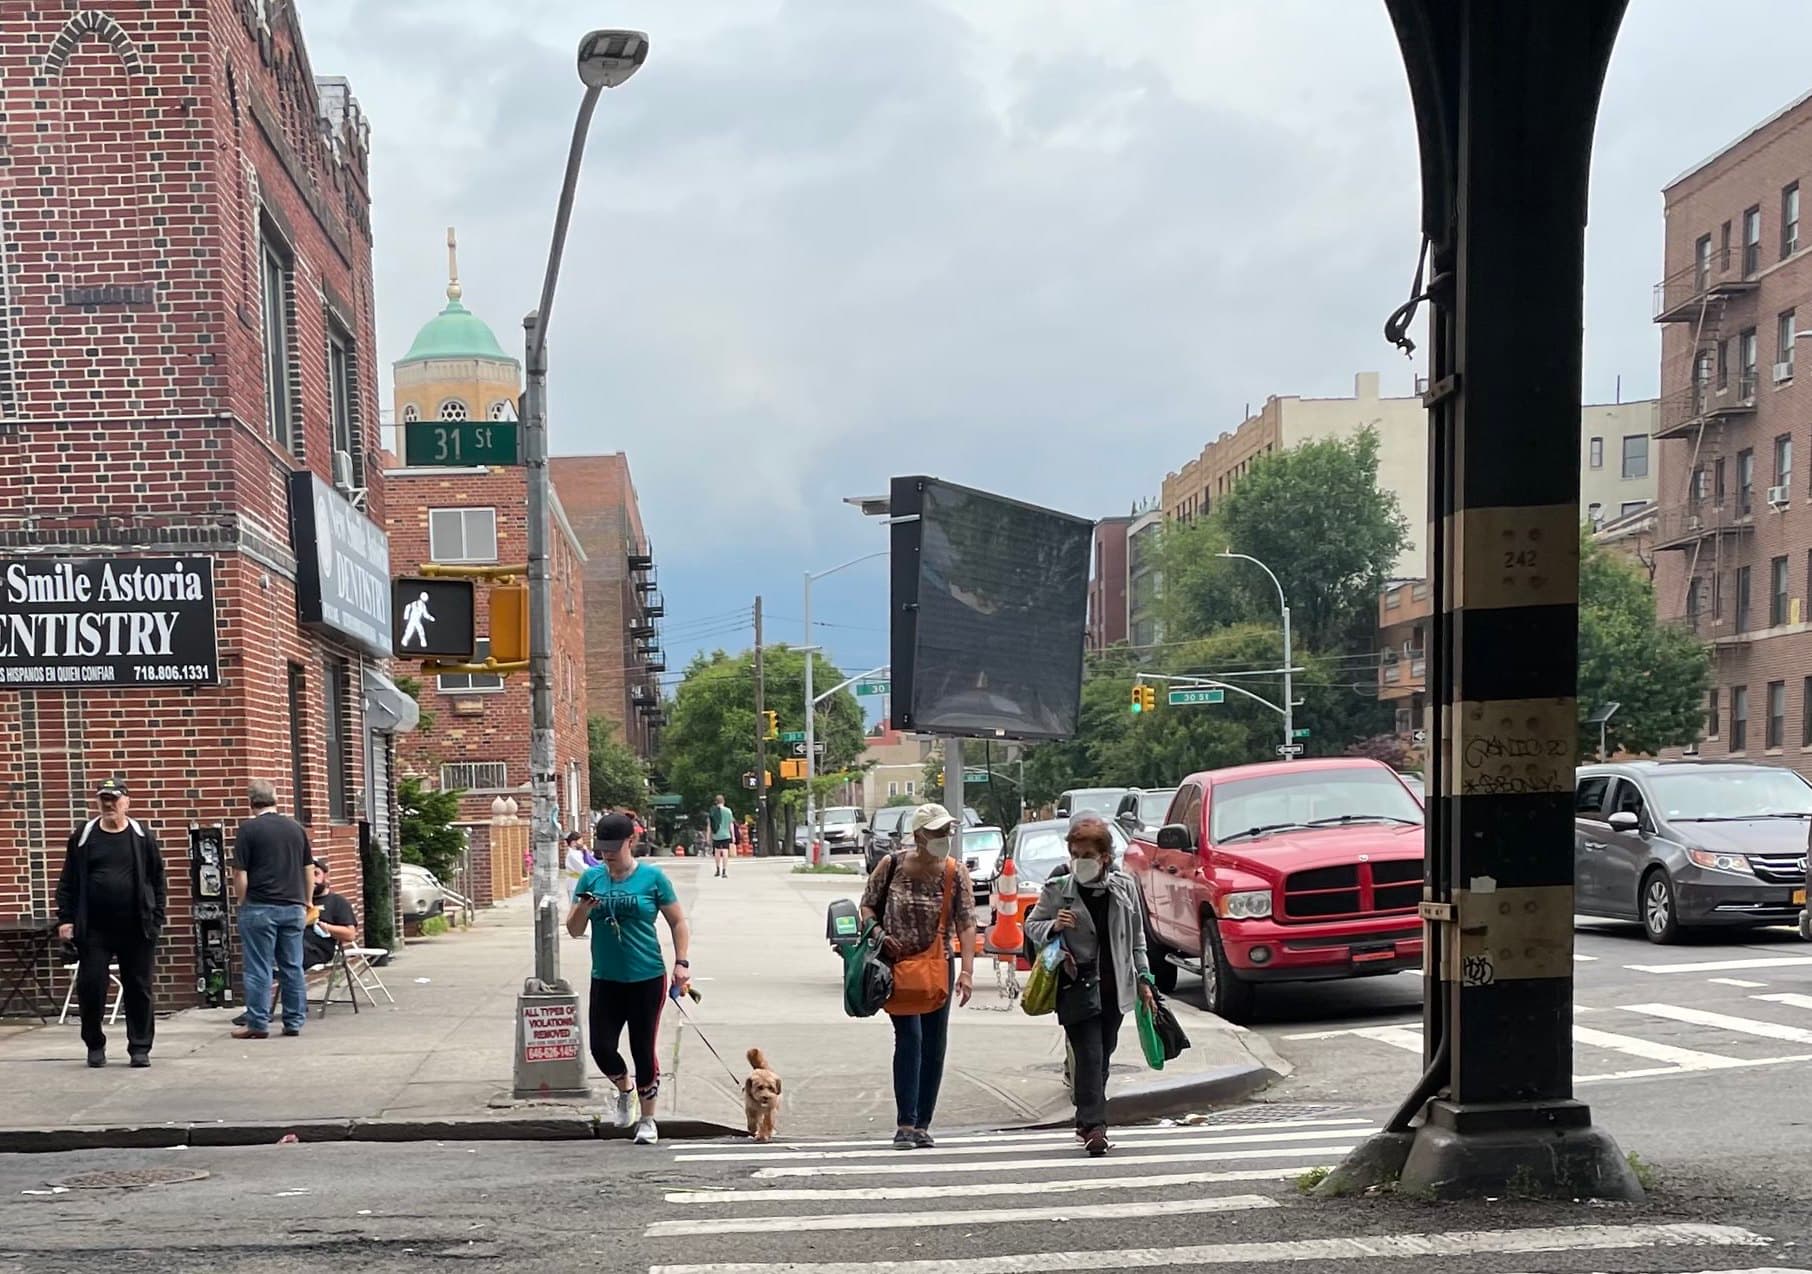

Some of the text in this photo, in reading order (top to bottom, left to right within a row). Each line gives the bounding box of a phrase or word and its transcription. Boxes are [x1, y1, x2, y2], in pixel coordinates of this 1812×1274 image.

[434, 428, 493, 460] 31 St
[1504, 550, 1537, 568] 242
[7, 561, 203, 603] Smile Astoria
[6, 666, 44, 682] HISPANOS
[45, 667, 56, 682] EN
[57, 666, 80, 682] QUIEN
[81, 666, 115, 681] CONFIAR
[133, 665, 209, 681] 718.806.1331
[872, 685, 885, 693] 30
[525, 1008, 539, 1017] ALL
[533, 1029, 571, 1039] REMOVED
